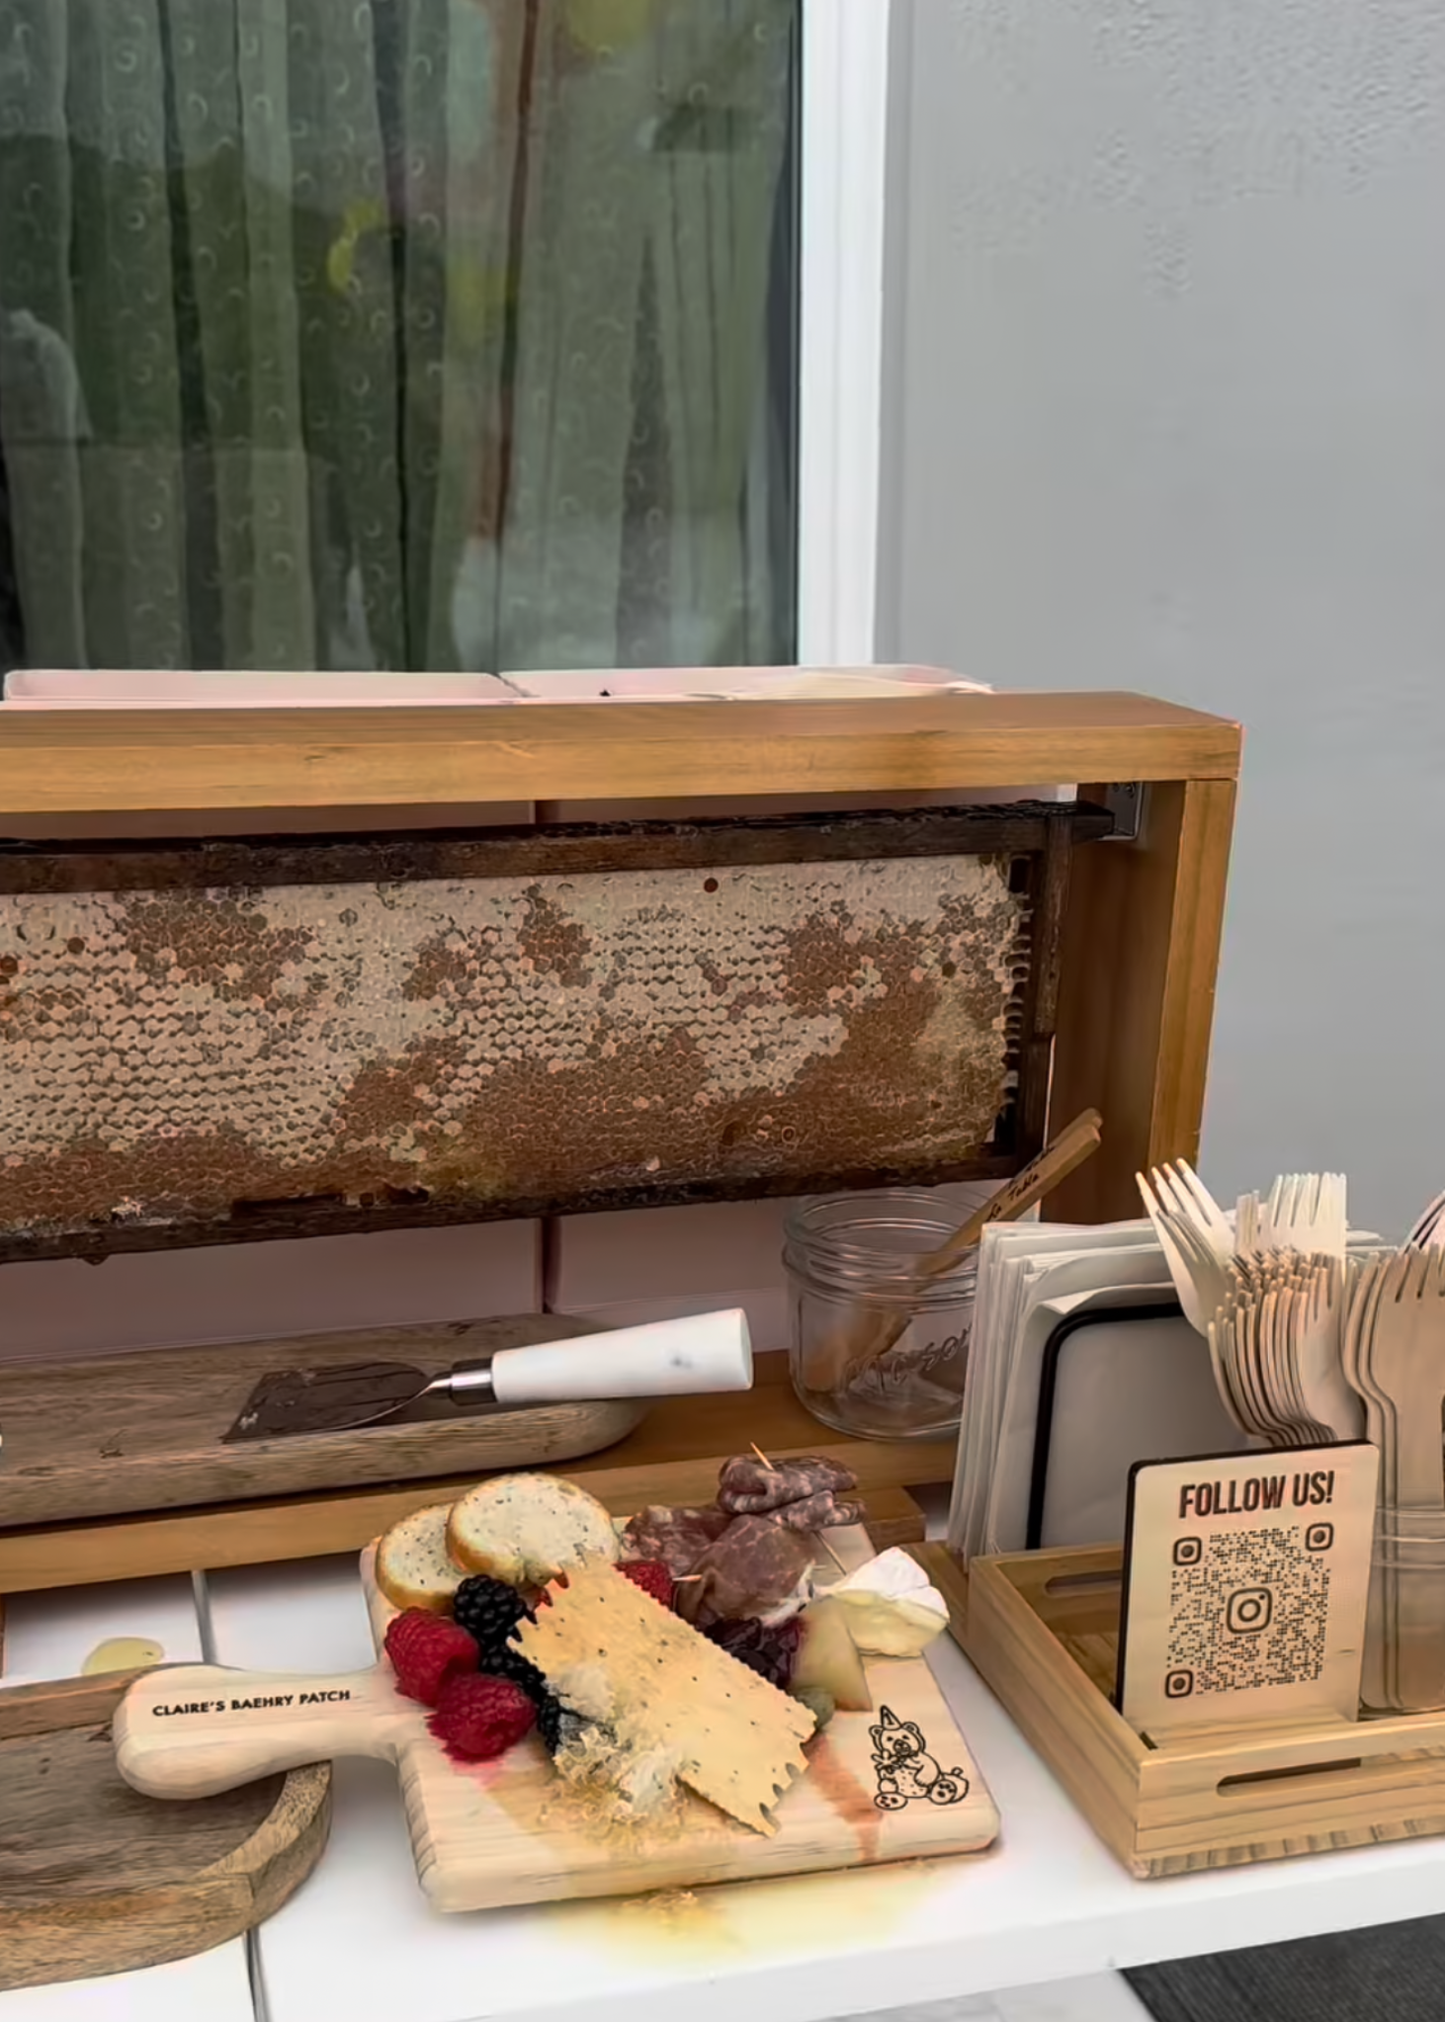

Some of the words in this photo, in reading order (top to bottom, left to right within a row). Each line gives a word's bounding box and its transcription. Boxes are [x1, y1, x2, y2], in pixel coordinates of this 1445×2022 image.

[1179, 1475, 1286, 1519] FOLLOW
[1292, 1470, 1334, 1507] US!
[152, 1701, 225, 1717] CLAIRE'S
[231, 1695, 293, 1711] BAEHRY
[299, 1690, 351, 1705] PATCH
